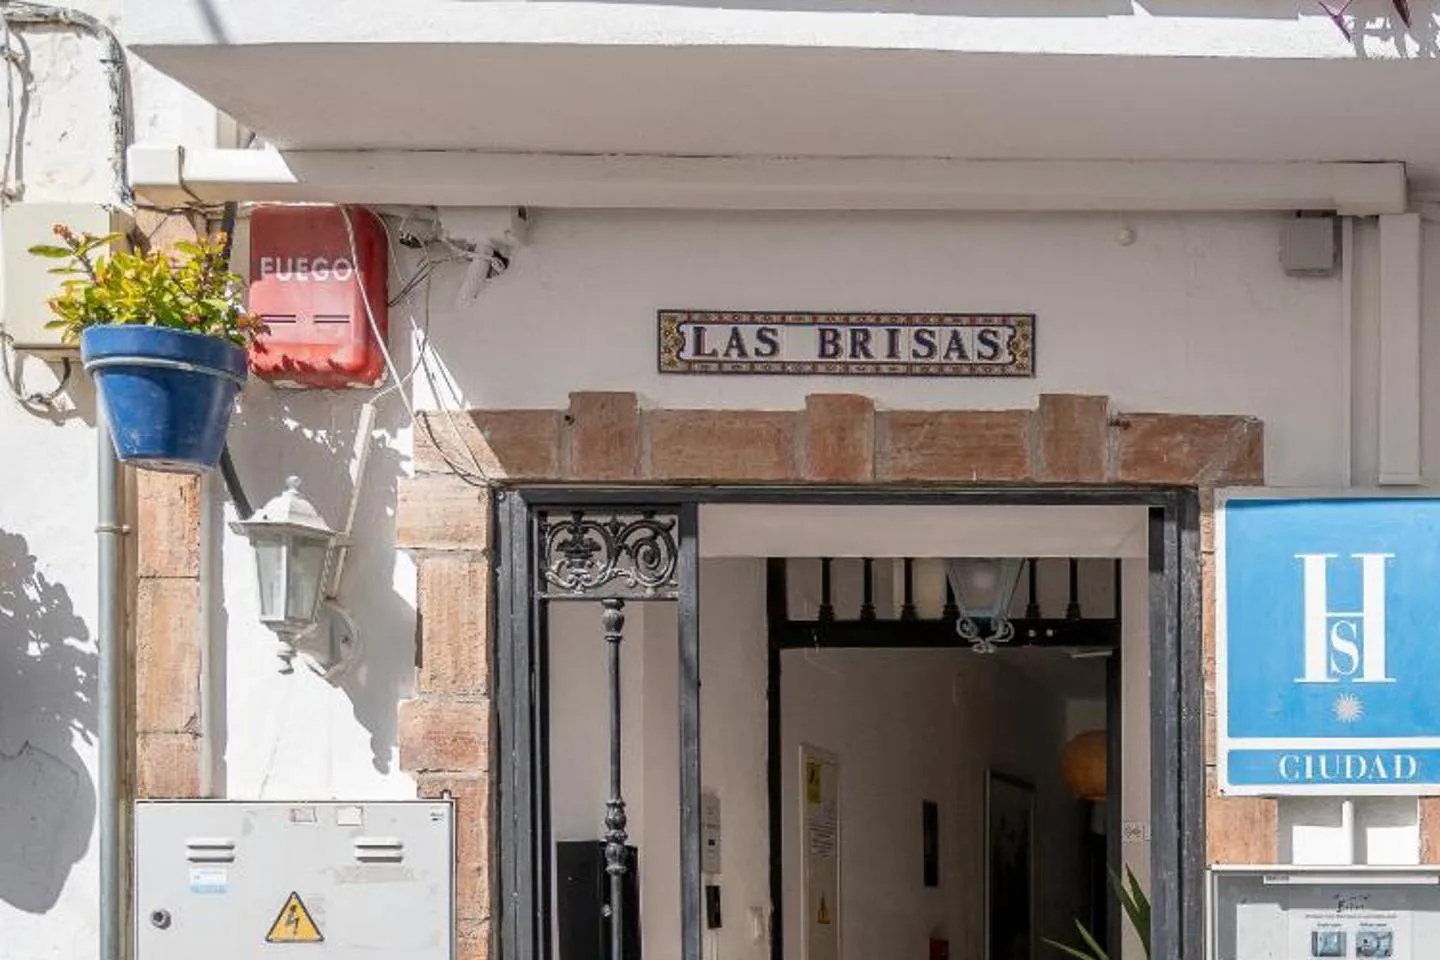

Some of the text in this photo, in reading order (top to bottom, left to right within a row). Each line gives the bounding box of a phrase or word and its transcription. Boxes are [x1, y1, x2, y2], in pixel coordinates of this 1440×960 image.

[260, 256, 352, 281] FUEGO
[691, 326, 1002, 361] LAS BRISAS
[1278, 754, 1418, 780] CIUDAD
